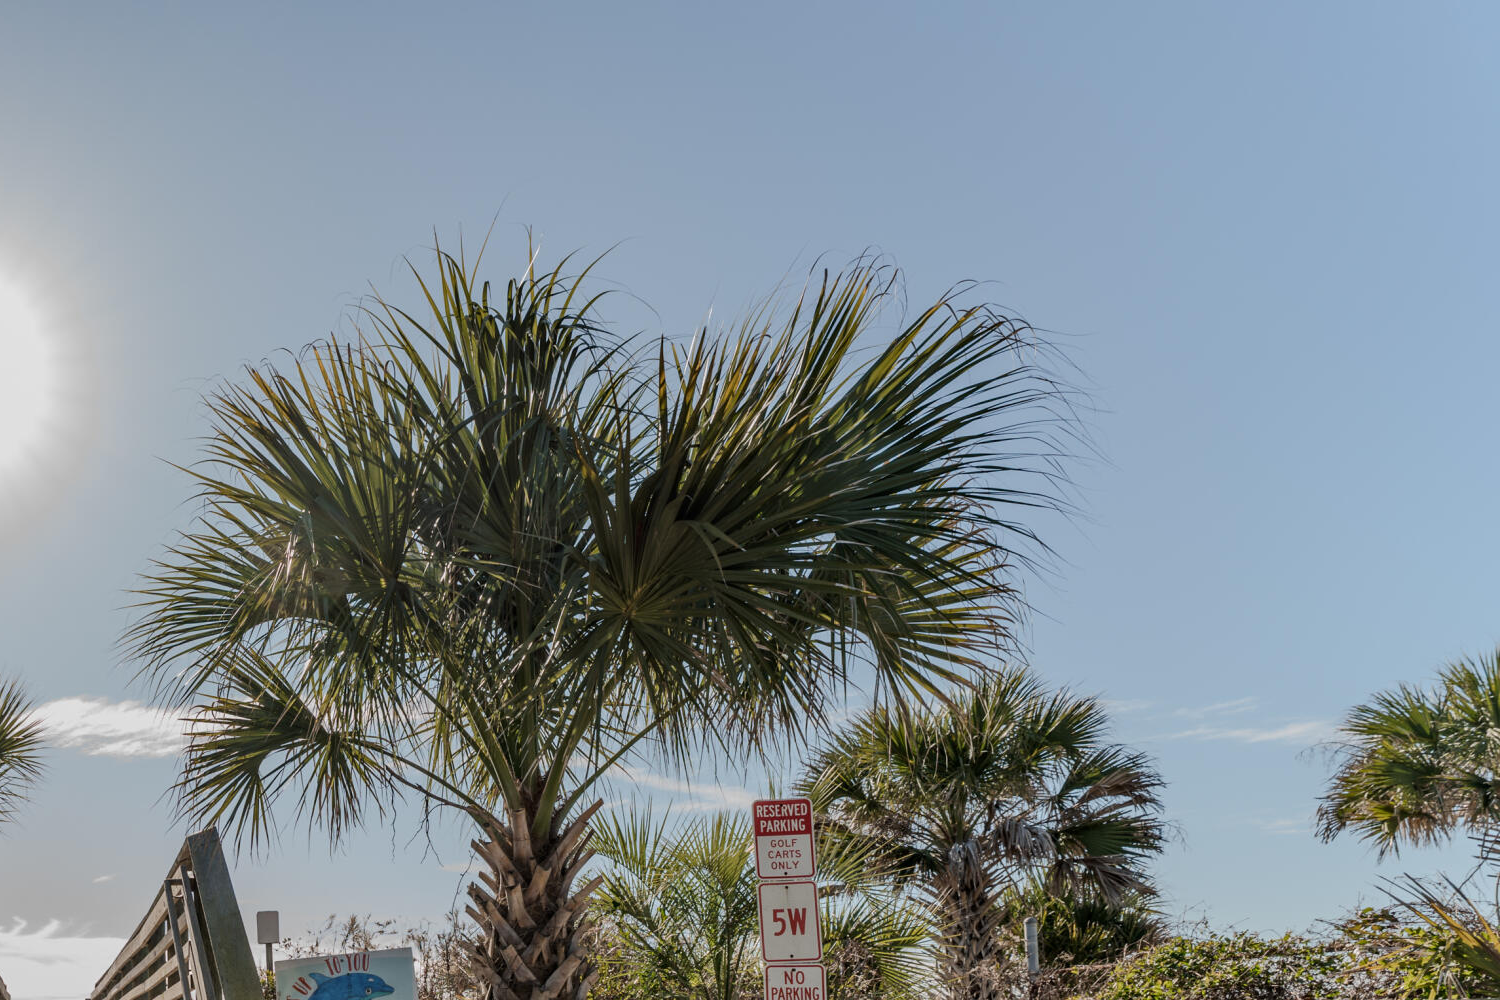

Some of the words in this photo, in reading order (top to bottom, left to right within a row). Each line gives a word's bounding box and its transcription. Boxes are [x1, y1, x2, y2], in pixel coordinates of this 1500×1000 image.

[756, 803, 808, 817] RESERVED
[760, 818, 806, 832] PARKING
[770, 838, 797, 848] GOLF
[768, 850, 802, 859] CARTS
[771, 861, 800, 870] ONLY
[772, 908, 807, 936] 5W
[292, 976, 312, 995] UP
[324, 956, 342, 976] TO
[345, 953, 370, 972] YOU
[784, 971, 804, 985] NO
[771, 987, 820, 1000] PARKING
